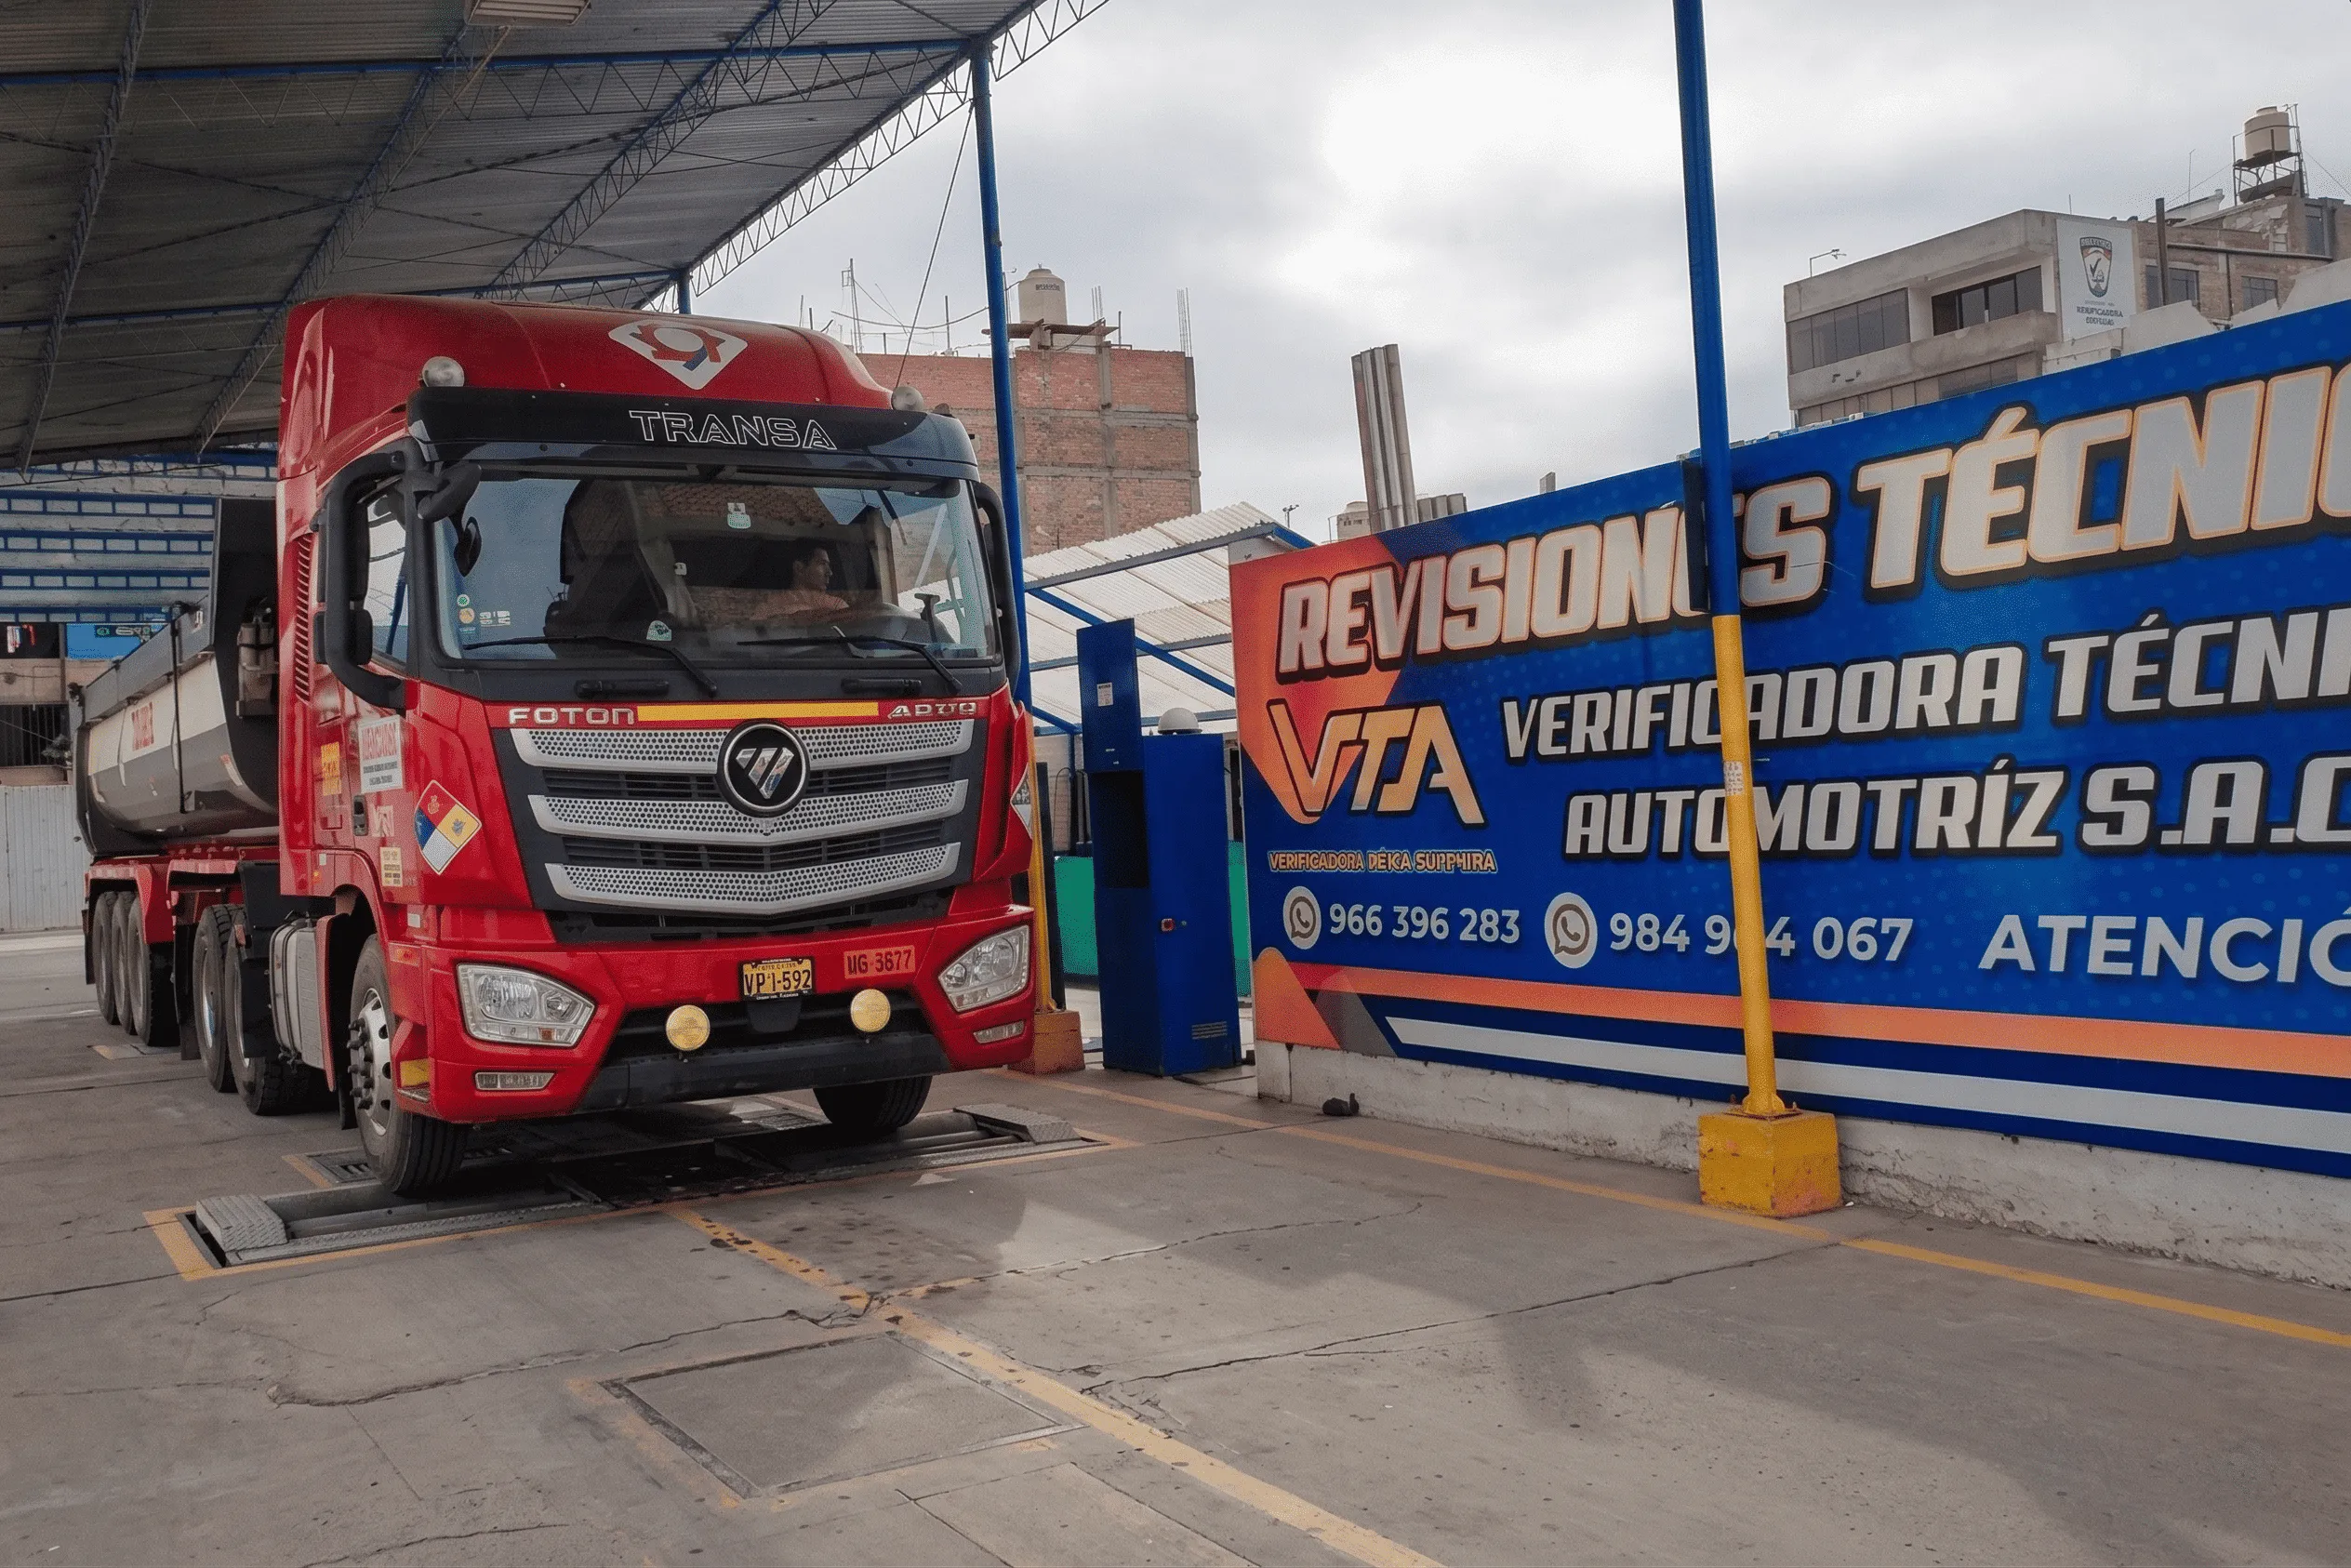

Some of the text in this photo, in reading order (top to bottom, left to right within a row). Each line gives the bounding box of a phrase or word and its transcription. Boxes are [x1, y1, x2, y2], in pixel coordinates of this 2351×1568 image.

[629, 410, 837, 450] TRANSA
[509, 707, 634, 725] FOTON
[1268, 851, 1364, 871] VERIFICADORA
[1329, 903, 1520, 944] 966 396 283
[1610, 912, 1913, 963] 984 94 067
